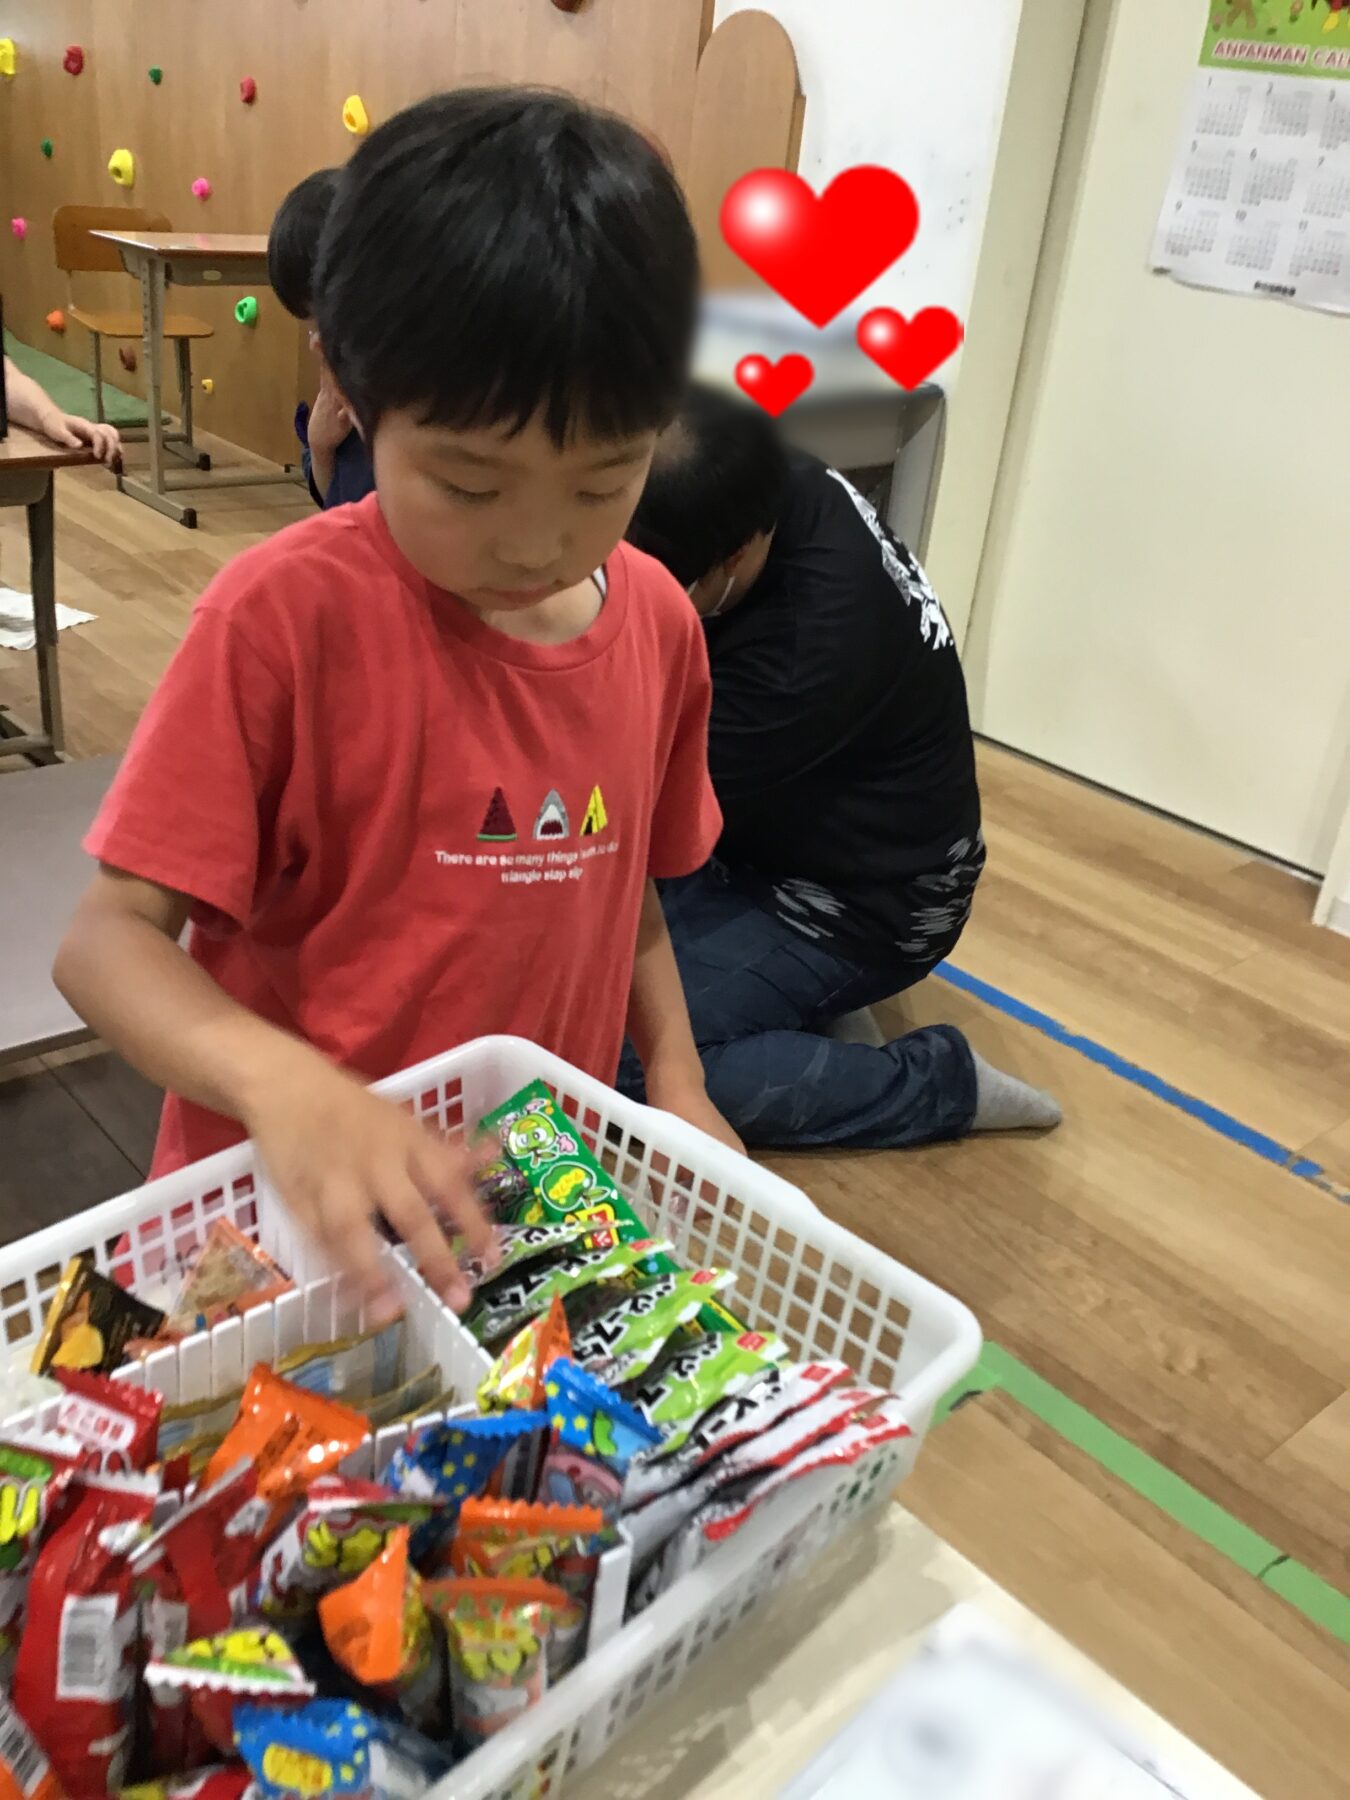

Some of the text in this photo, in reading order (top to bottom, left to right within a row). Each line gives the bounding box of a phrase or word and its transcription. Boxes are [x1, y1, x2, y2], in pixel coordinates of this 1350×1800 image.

[1213, 41, 1309, 63] ANPANMAN
[434, 849, 473, 865] There
[475, 854, 498, 866] are
[515, 854, 545, 867] many
[547, 851, 579, 865] things
